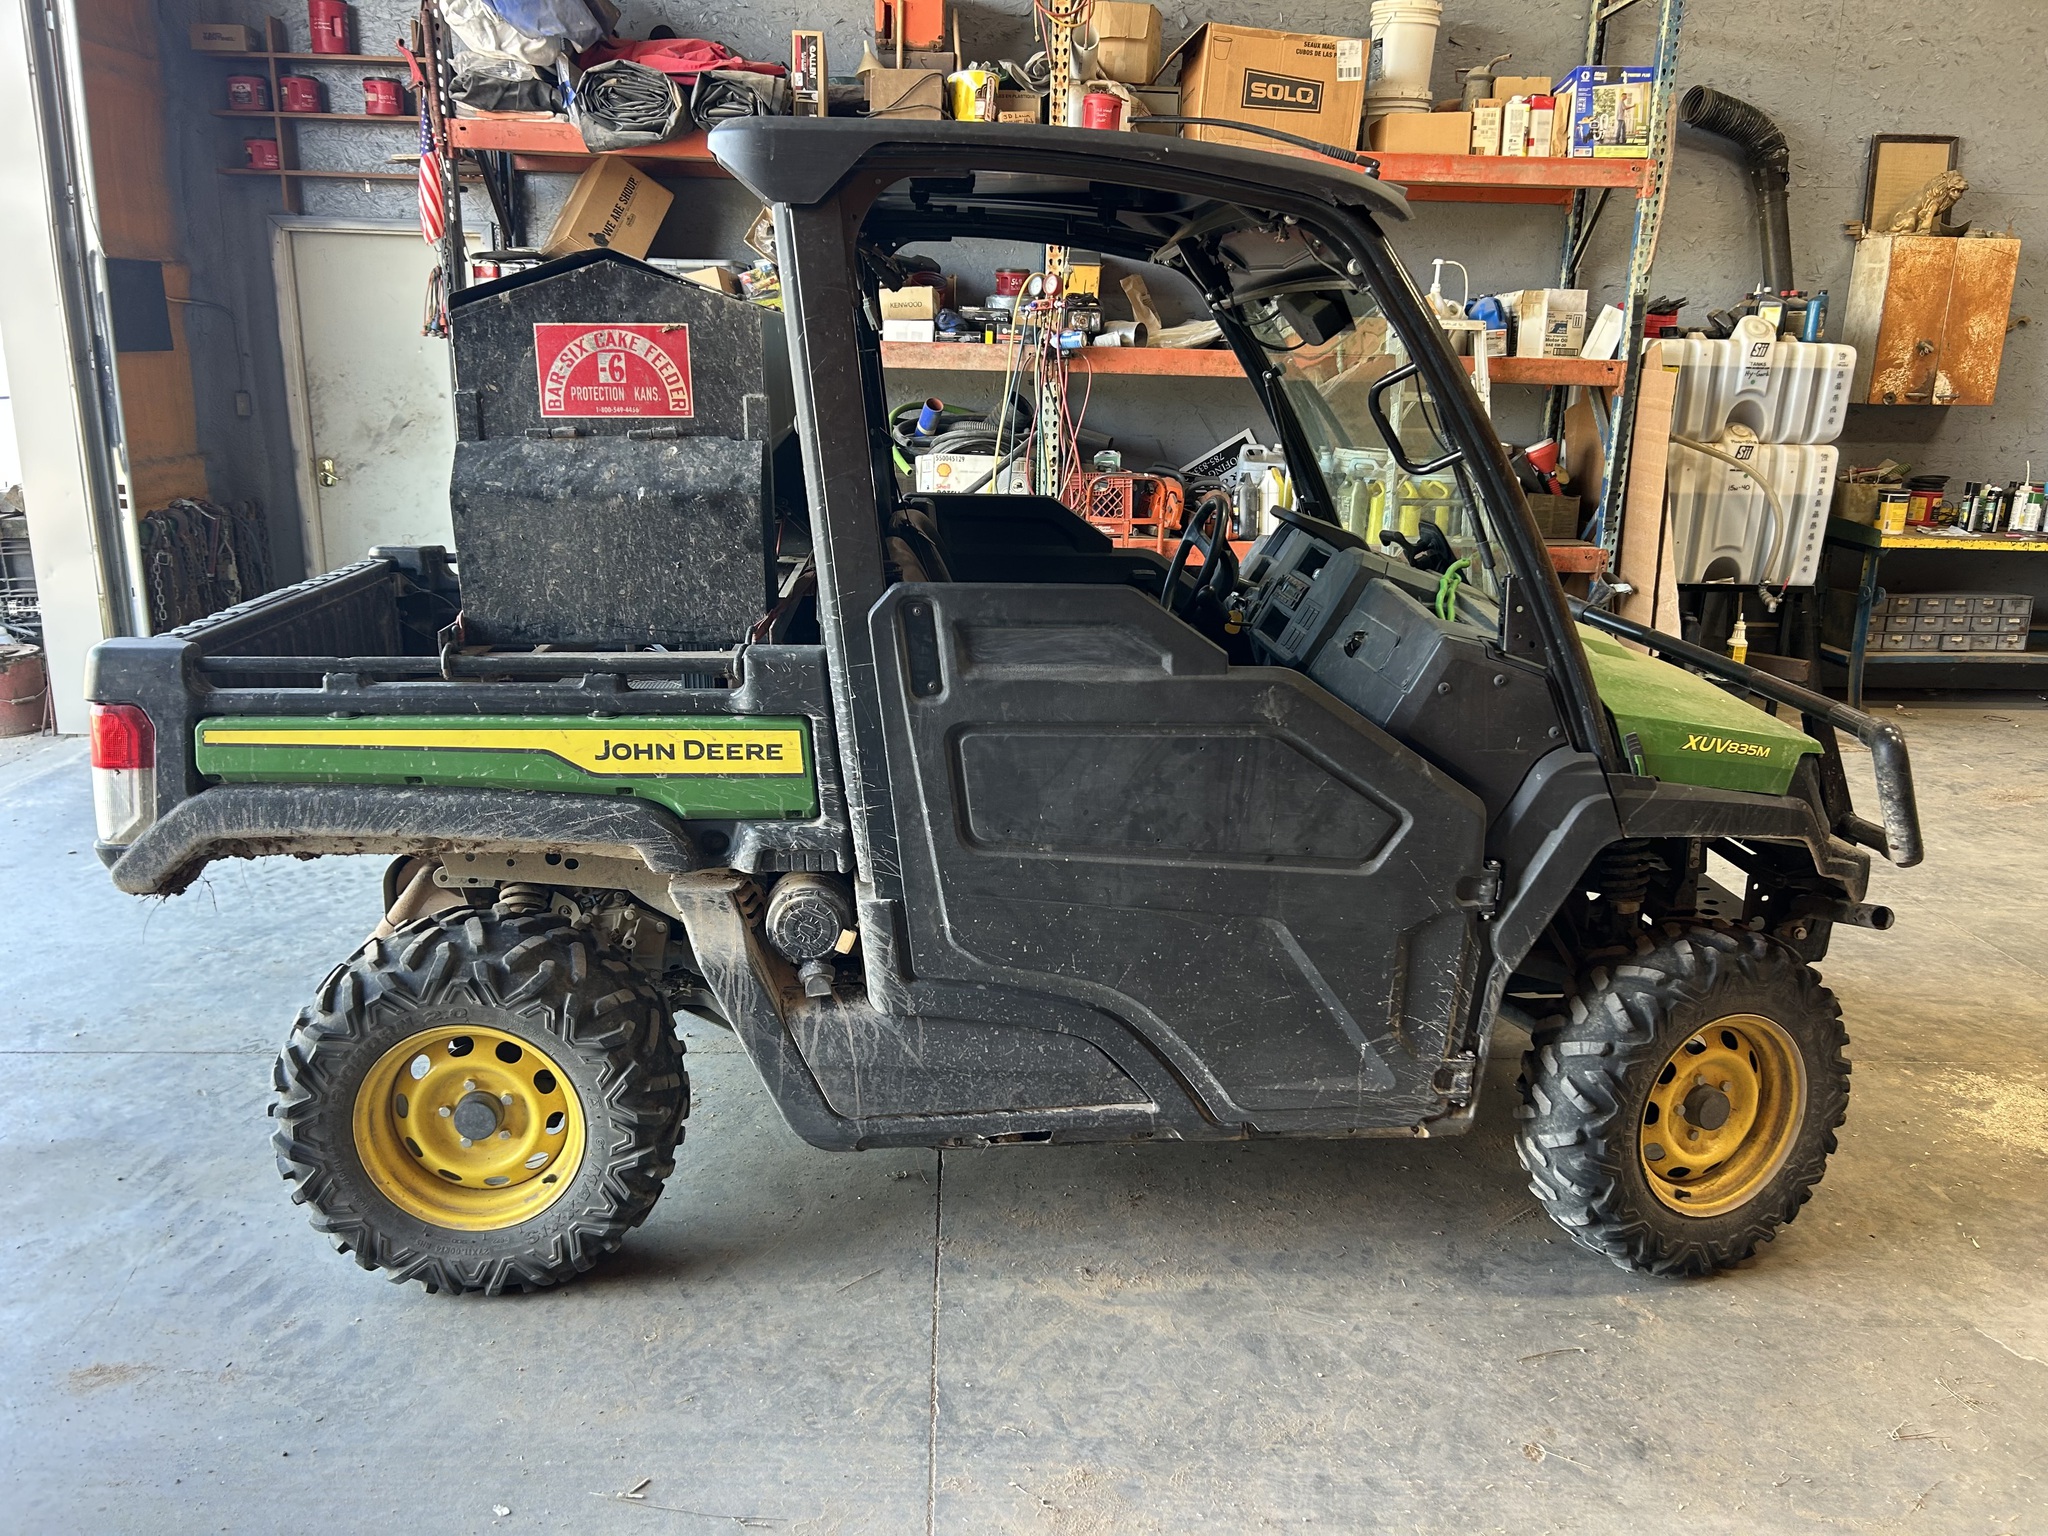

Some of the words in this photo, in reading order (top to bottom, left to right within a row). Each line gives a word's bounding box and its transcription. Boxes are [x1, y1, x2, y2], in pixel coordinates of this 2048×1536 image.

[1295, 48, 1314, 56] CUBOS
[1303, 41, 1321, 49] SEAUX
[1250, 81, 1314, 103] SOLO
[602, 220, 617, 237] WE
[610, 203, 625, 222] ARE
[889, 301, 923, 309] KENWOOD
[547, 337, 589, 409] BAR-SIX
[593, 331, 641, 352] CAKE
[643, 344, 687, 410] FEEDER
[600, 354, 625, 382] -6
[570, 386, 625, 401] PROTECTION
[634, 386, 662, 401] KANS.
[594, 739, 676, 761] JOHN
[683, 739, 784, 761] DEERE
[1681, 733, 1771, 758] XUV835M
